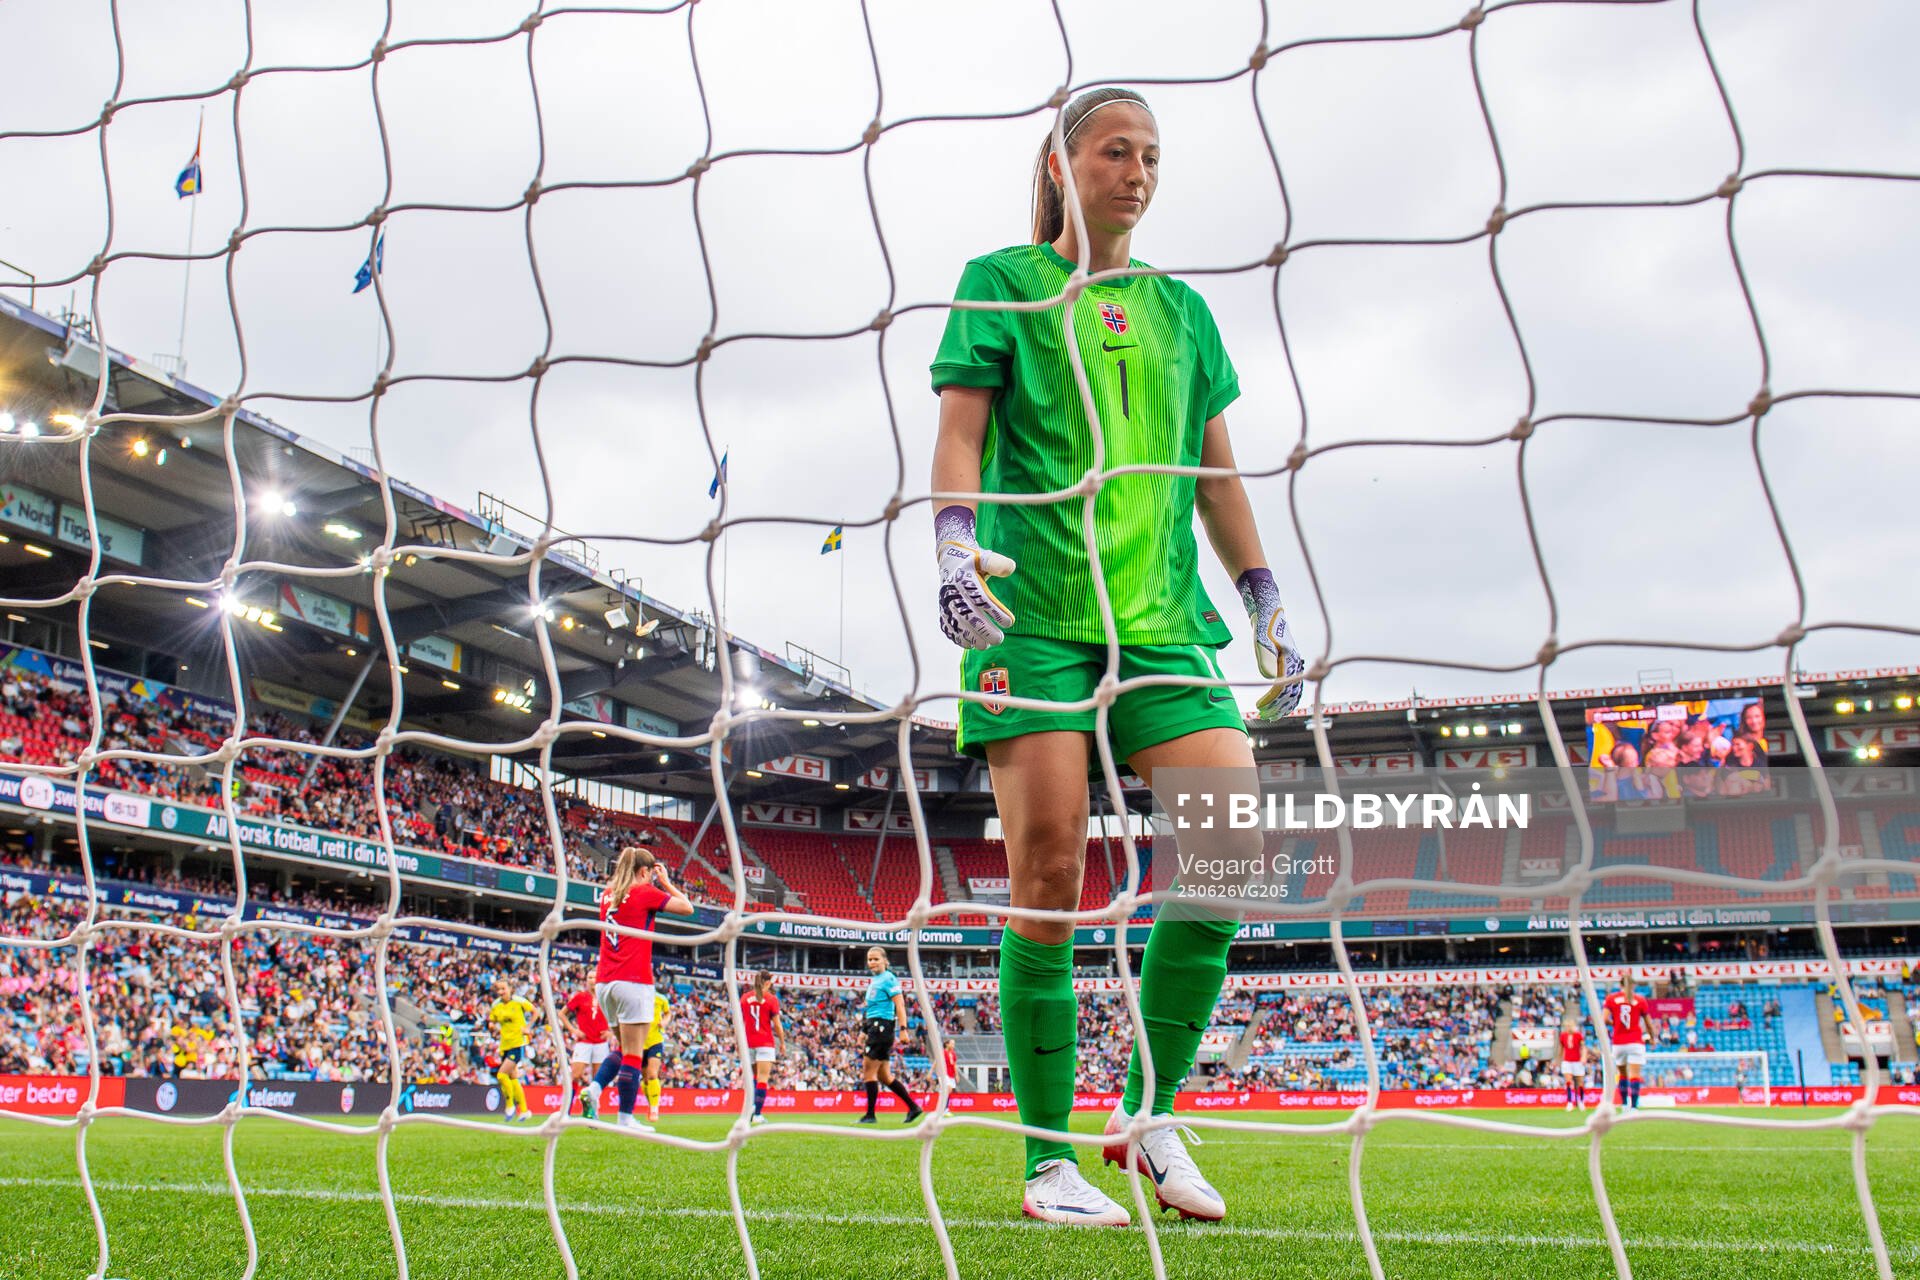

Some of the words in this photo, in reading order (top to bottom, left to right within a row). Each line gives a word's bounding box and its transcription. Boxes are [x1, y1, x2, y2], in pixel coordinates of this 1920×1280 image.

[1116, 359, 1130, 421] 1
[63, 516, 113, 552] Tippg
[768, 756, 823, 779] VG
[1337, 754, 1413, 776] VG
[1446, 747, 1526, 769] VG
[749, 805, 816, 827] VG
[206, 815, 228, 837] All
[274, 829, 321, 857] fotball,
[322, 841, 346, 859] rett
[347, 843, 353, 860] i
[355, 844, 375, 863] din
[1528, 915, 1547, 929] All
[1550, 914, 1592, 928] nosk
[1595, 912, 1649, 929] fotball,
[1650, 911, 1678, 926] rett
[1688, 910, 1713, 924] din
[780, 921, 793, 934] All
[794, 923, 823, 938] norsk
[825, 925, 864, 941] fotball,
[866, 929, 887, 941] rett
[1253, 923, 1275, 938] nå!
[800, 975, 830, 987] VG
[838, 977, 872, 988] VG
[1242, 976, 1281, 986] VG
[1290, 975, 1329, 985] VG
[1386, 972, 1427, 982] VG
[1436, 971, 1477, 982] VG
[1486, 970, 1528, 980] VG
[1538, 969, 1579, 979] VG
[1697, 965, 1740, 975] VG
[1750, 964, 1795, 974] VG
[27, 1081, 78, 1104] bedre
[250, 1087, 296, 1107] telenor
[413, 1090, 451, 1108] telenor
[1195, 1096, 1235, 1109] equinor
[1313, 1095, 1338, 1105] etter
[1341, 1093, 1368, 1105] bedr
[1415, 1094, 1458, 1107] equinor
[1813, 1089, 1852, 1102] bedre
